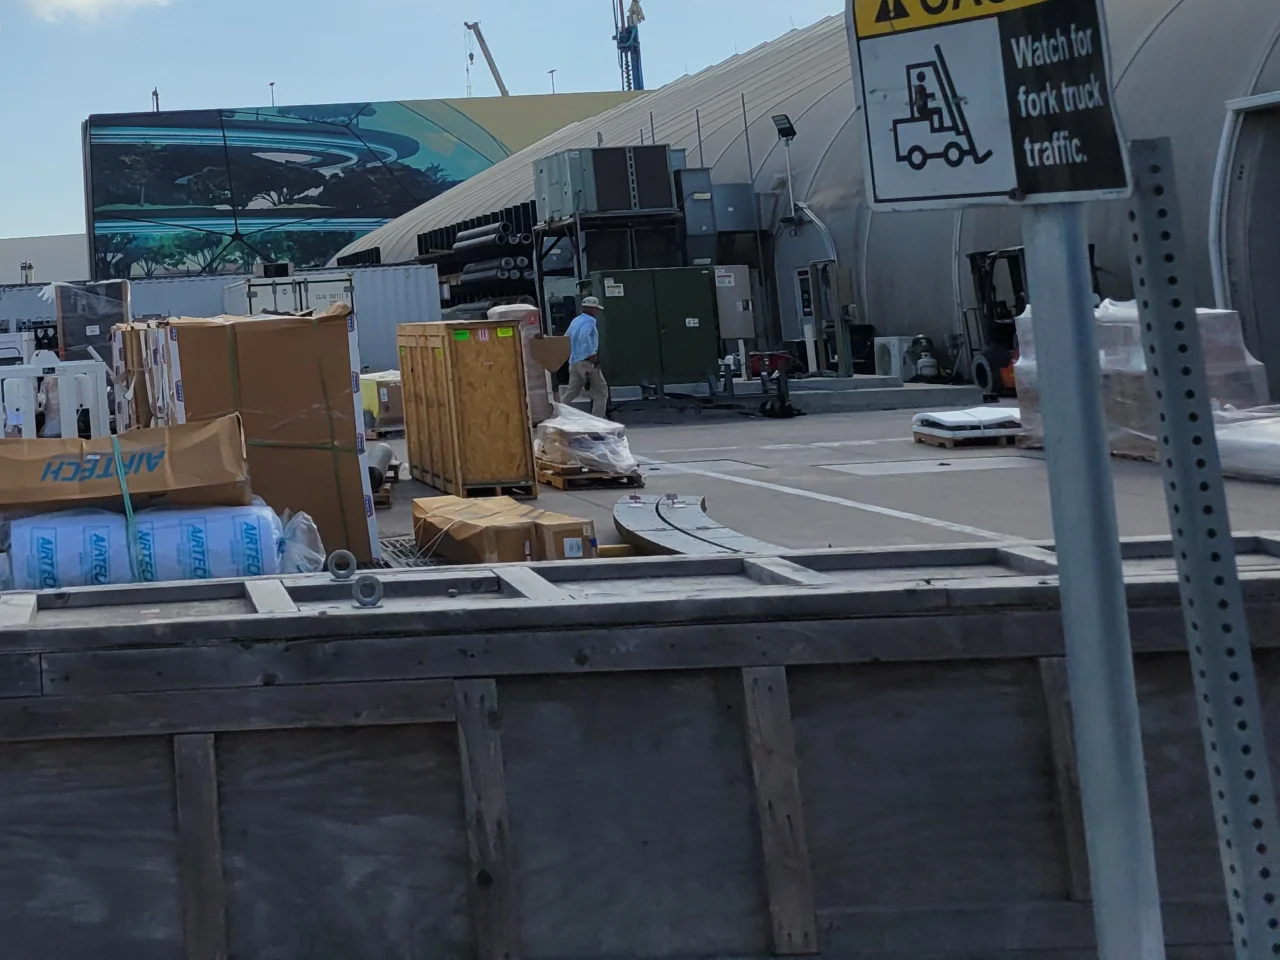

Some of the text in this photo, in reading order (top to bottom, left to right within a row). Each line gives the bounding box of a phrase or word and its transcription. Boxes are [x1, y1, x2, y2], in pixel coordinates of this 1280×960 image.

[1010, 23, 1093, 69] Watch for
[1017, 72, 1104, 118] fork truck
[1023, 130, 1088, 167] traffic.
[41, 451, 165, 482] AIRTECH
